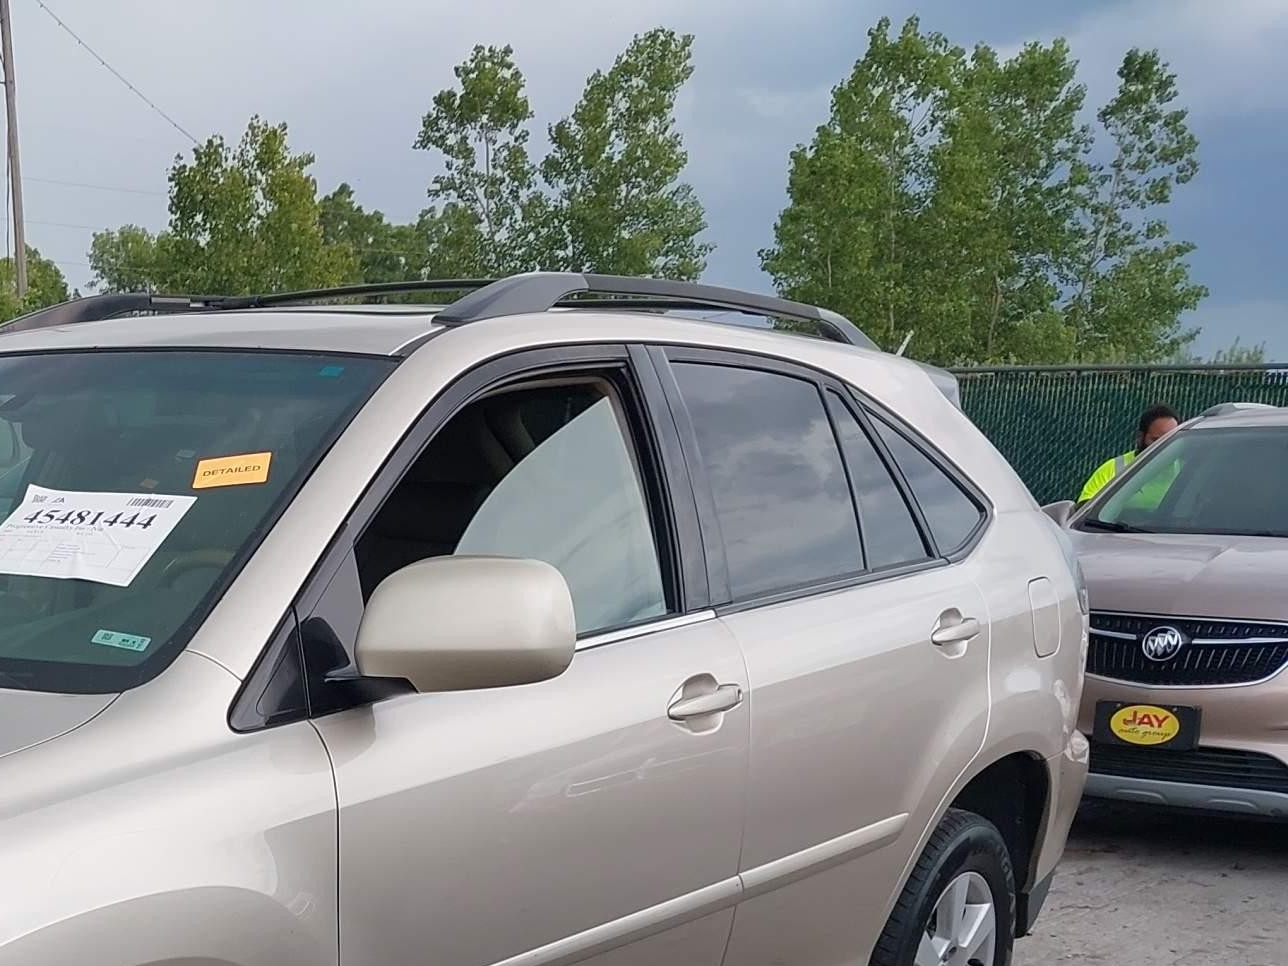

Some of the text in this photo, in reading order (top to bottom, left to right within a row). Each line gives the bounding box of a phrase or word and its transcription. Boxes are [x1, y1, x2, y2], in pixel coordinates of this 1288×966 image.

[202, 465, 261, 477] DETAILED
[23, 509, 158, 530] 45481444
[1122, 710, 1170, 729] JAY
